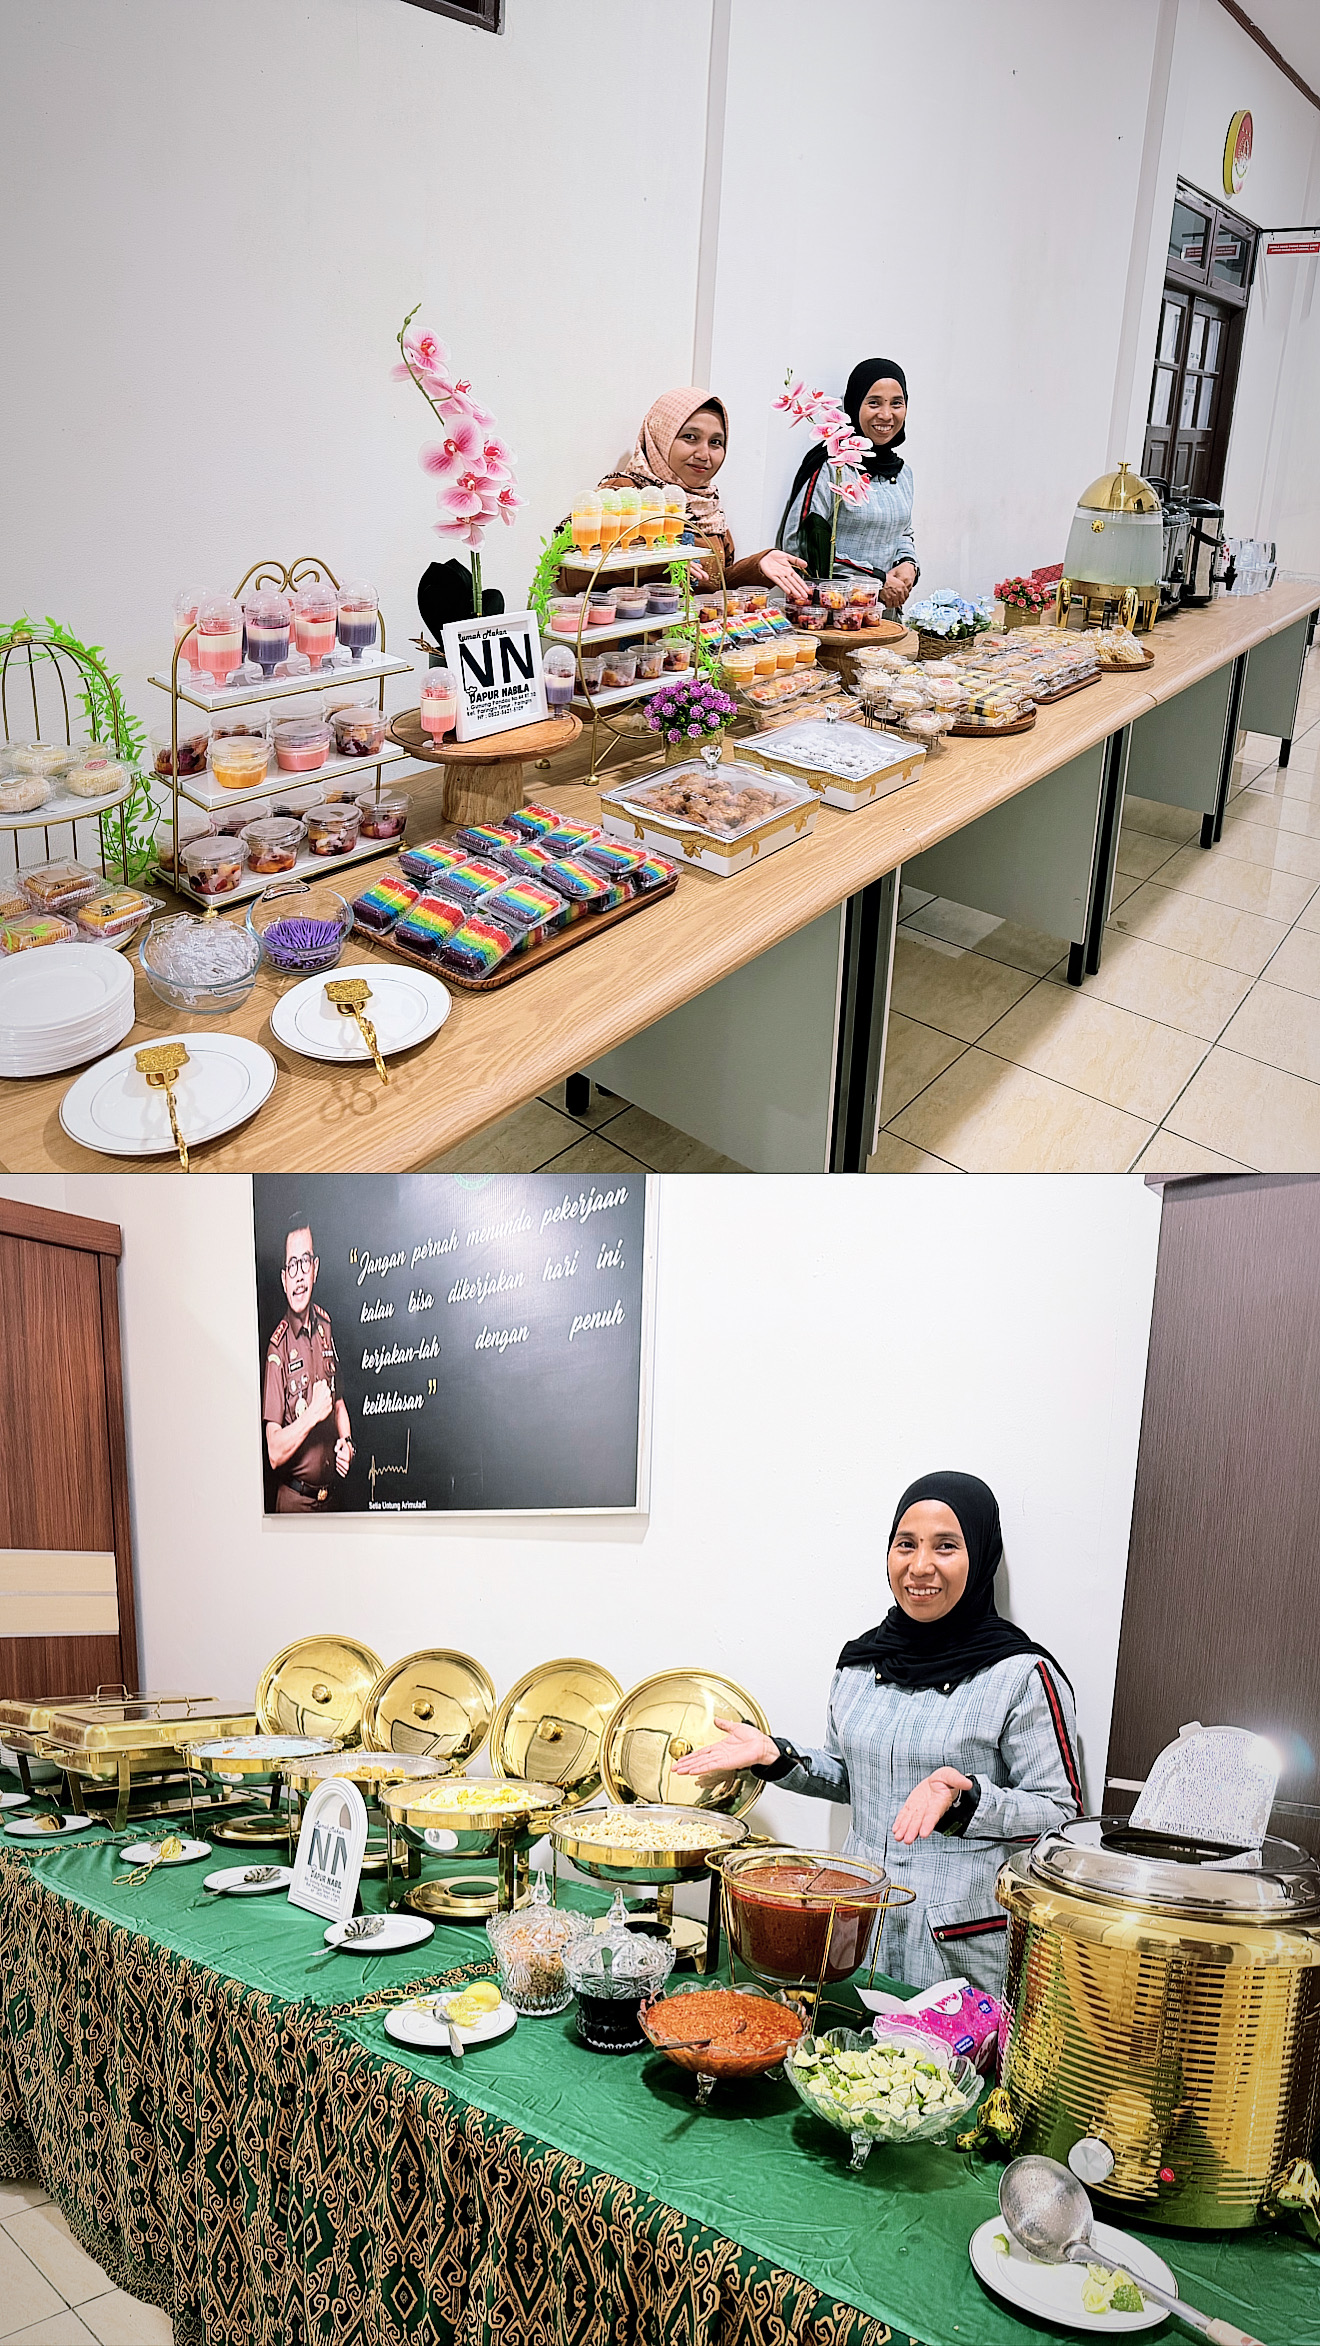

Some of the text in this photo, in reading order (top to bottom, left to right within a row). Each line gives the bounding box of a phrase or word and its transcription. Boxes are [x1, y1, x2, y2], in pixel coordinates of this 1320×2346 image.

[459, 633, 535, 688] NN
[483, 628, 507, 639] Makan
[469, 689, 500, 704] DAPUR
[411, 1229, 459, 1270] pernah
[466, 1208, 534, 1247] menunda
[540, 1186, 629, 1234] pekerjaan
[360, 1239, 626, 1323] kalau bisa dikerjakan hari ini,
[361, 1299, 626, 1374] kerjakan-lah dengan penuh
